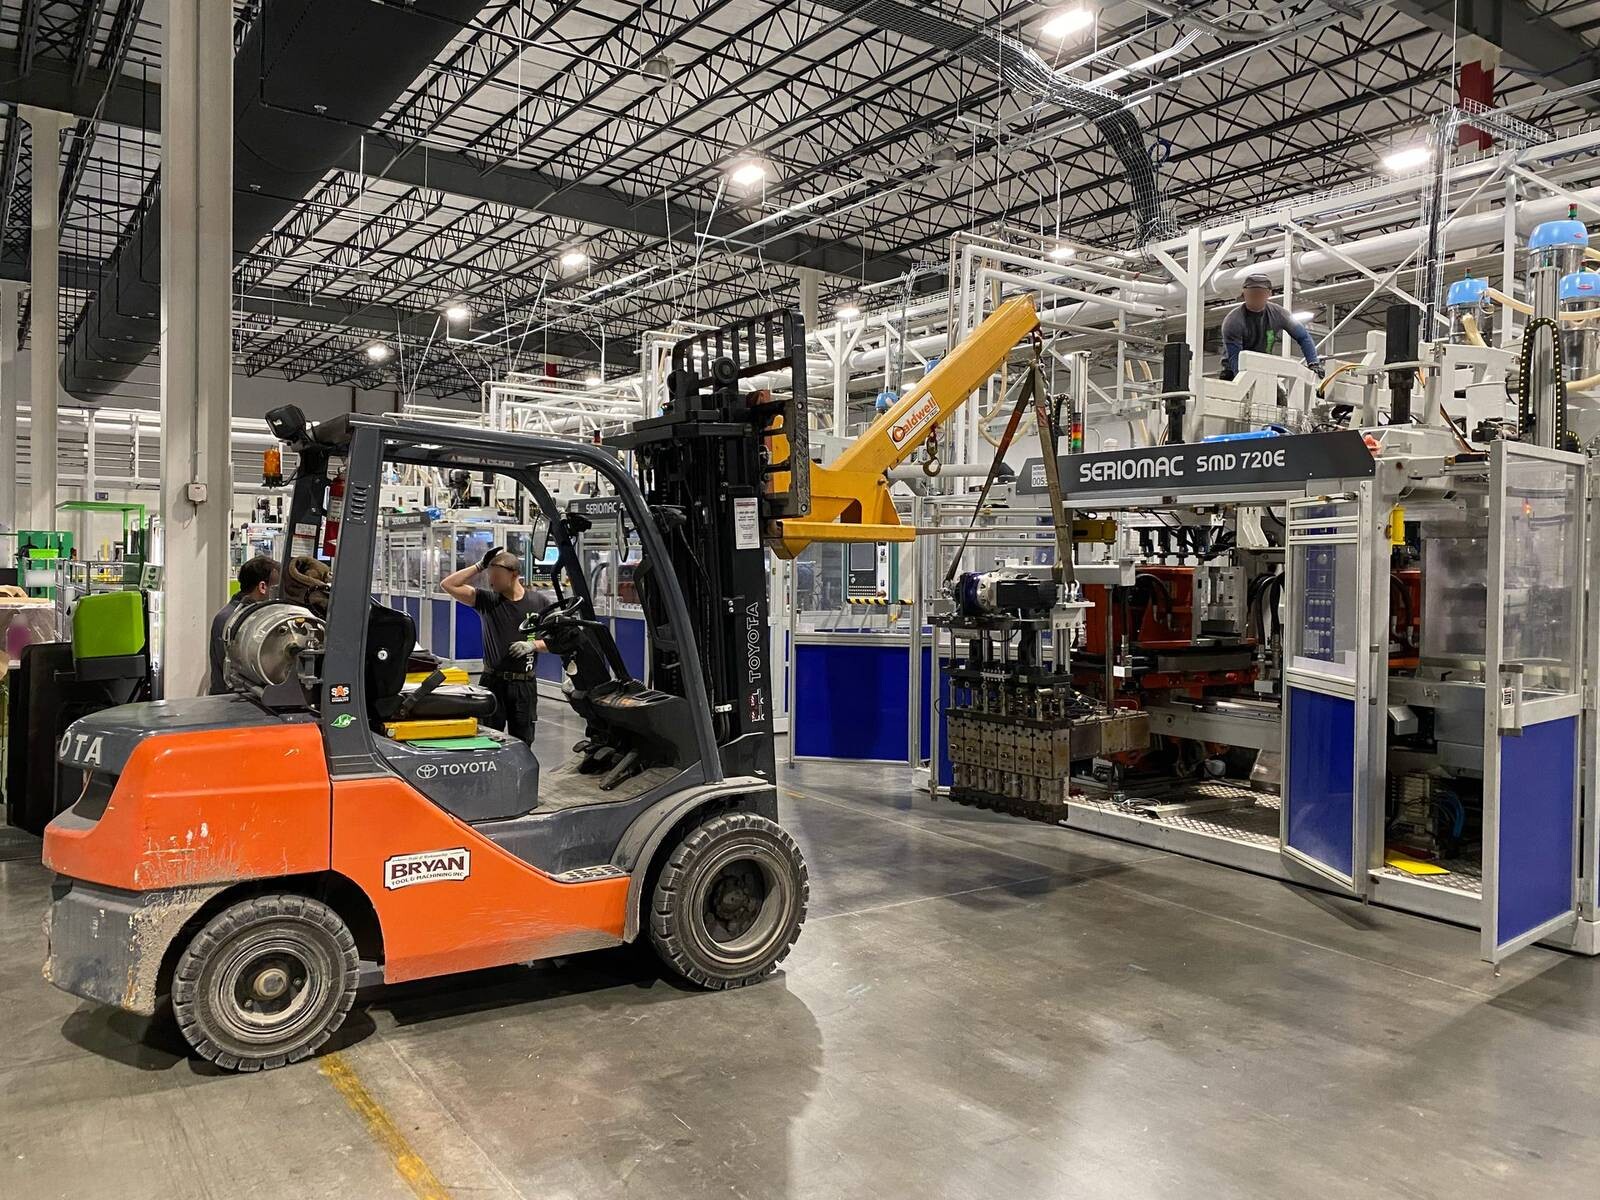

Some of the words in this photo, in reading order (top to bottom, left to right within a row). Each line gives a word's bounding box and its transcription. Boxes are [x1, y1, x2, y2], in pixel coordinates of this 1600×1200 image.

[892, 396, 936, 442] Caldwell
[1079, 456, 1184, 483] SERIOMAC
[1196, 454, 1236, 472] SMD
[1241, 449, 1286, 469] 720E
[585, 502, 618, 514] SERIOMAC
[746, 601, 762, 684] TOYOTA
[440, 760, 497, 776] TOYOTA
[391, 856, 465, 880] BRYAN
[391, 878, 408, 886] TOOL
[416, 872, 452, 881] MACHINING
